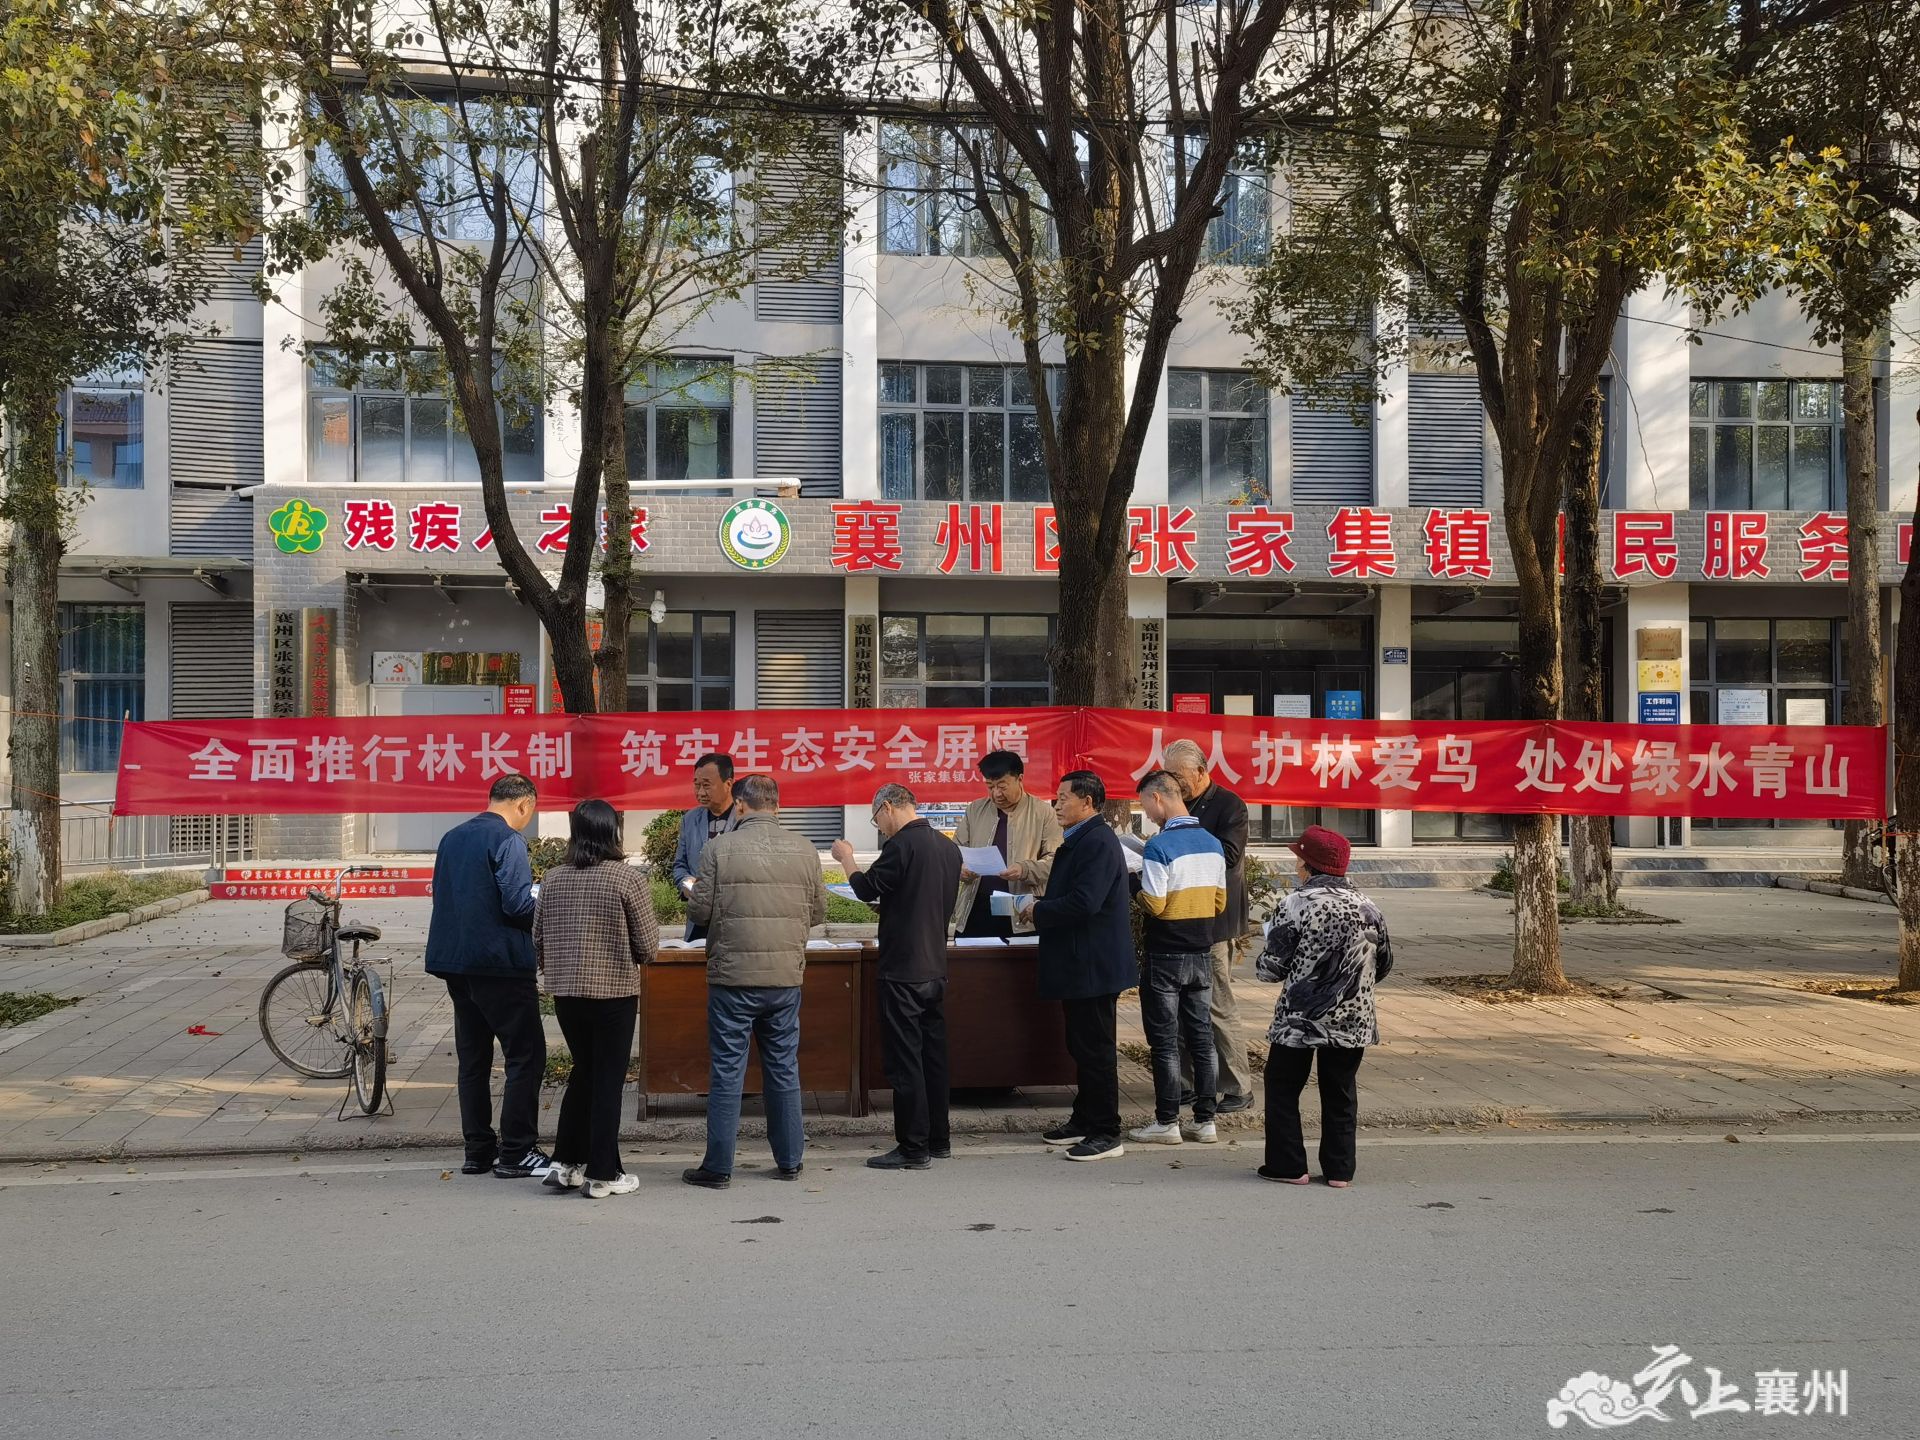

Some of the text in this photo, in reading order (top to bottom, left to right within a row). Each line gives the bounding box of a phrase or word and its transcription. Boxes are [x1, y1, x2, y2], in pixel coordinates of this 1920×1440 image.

[830, 500, 1913, 581] 襄州张家集镇民服务
[273, 612, 294, 718] 襄州区张家集镇综
[854, 623, 872, 708] 襄阳市襄州区张
[1140, 623, 1159, 709] 襄阳市襄州区张家集
[189, 722, 1850, 799] 全面推行林长制 筑牢生态安全屏障 人人护林爱鸟 处处绿水青山
[908, 770, 988, 784] 张家集镇人
